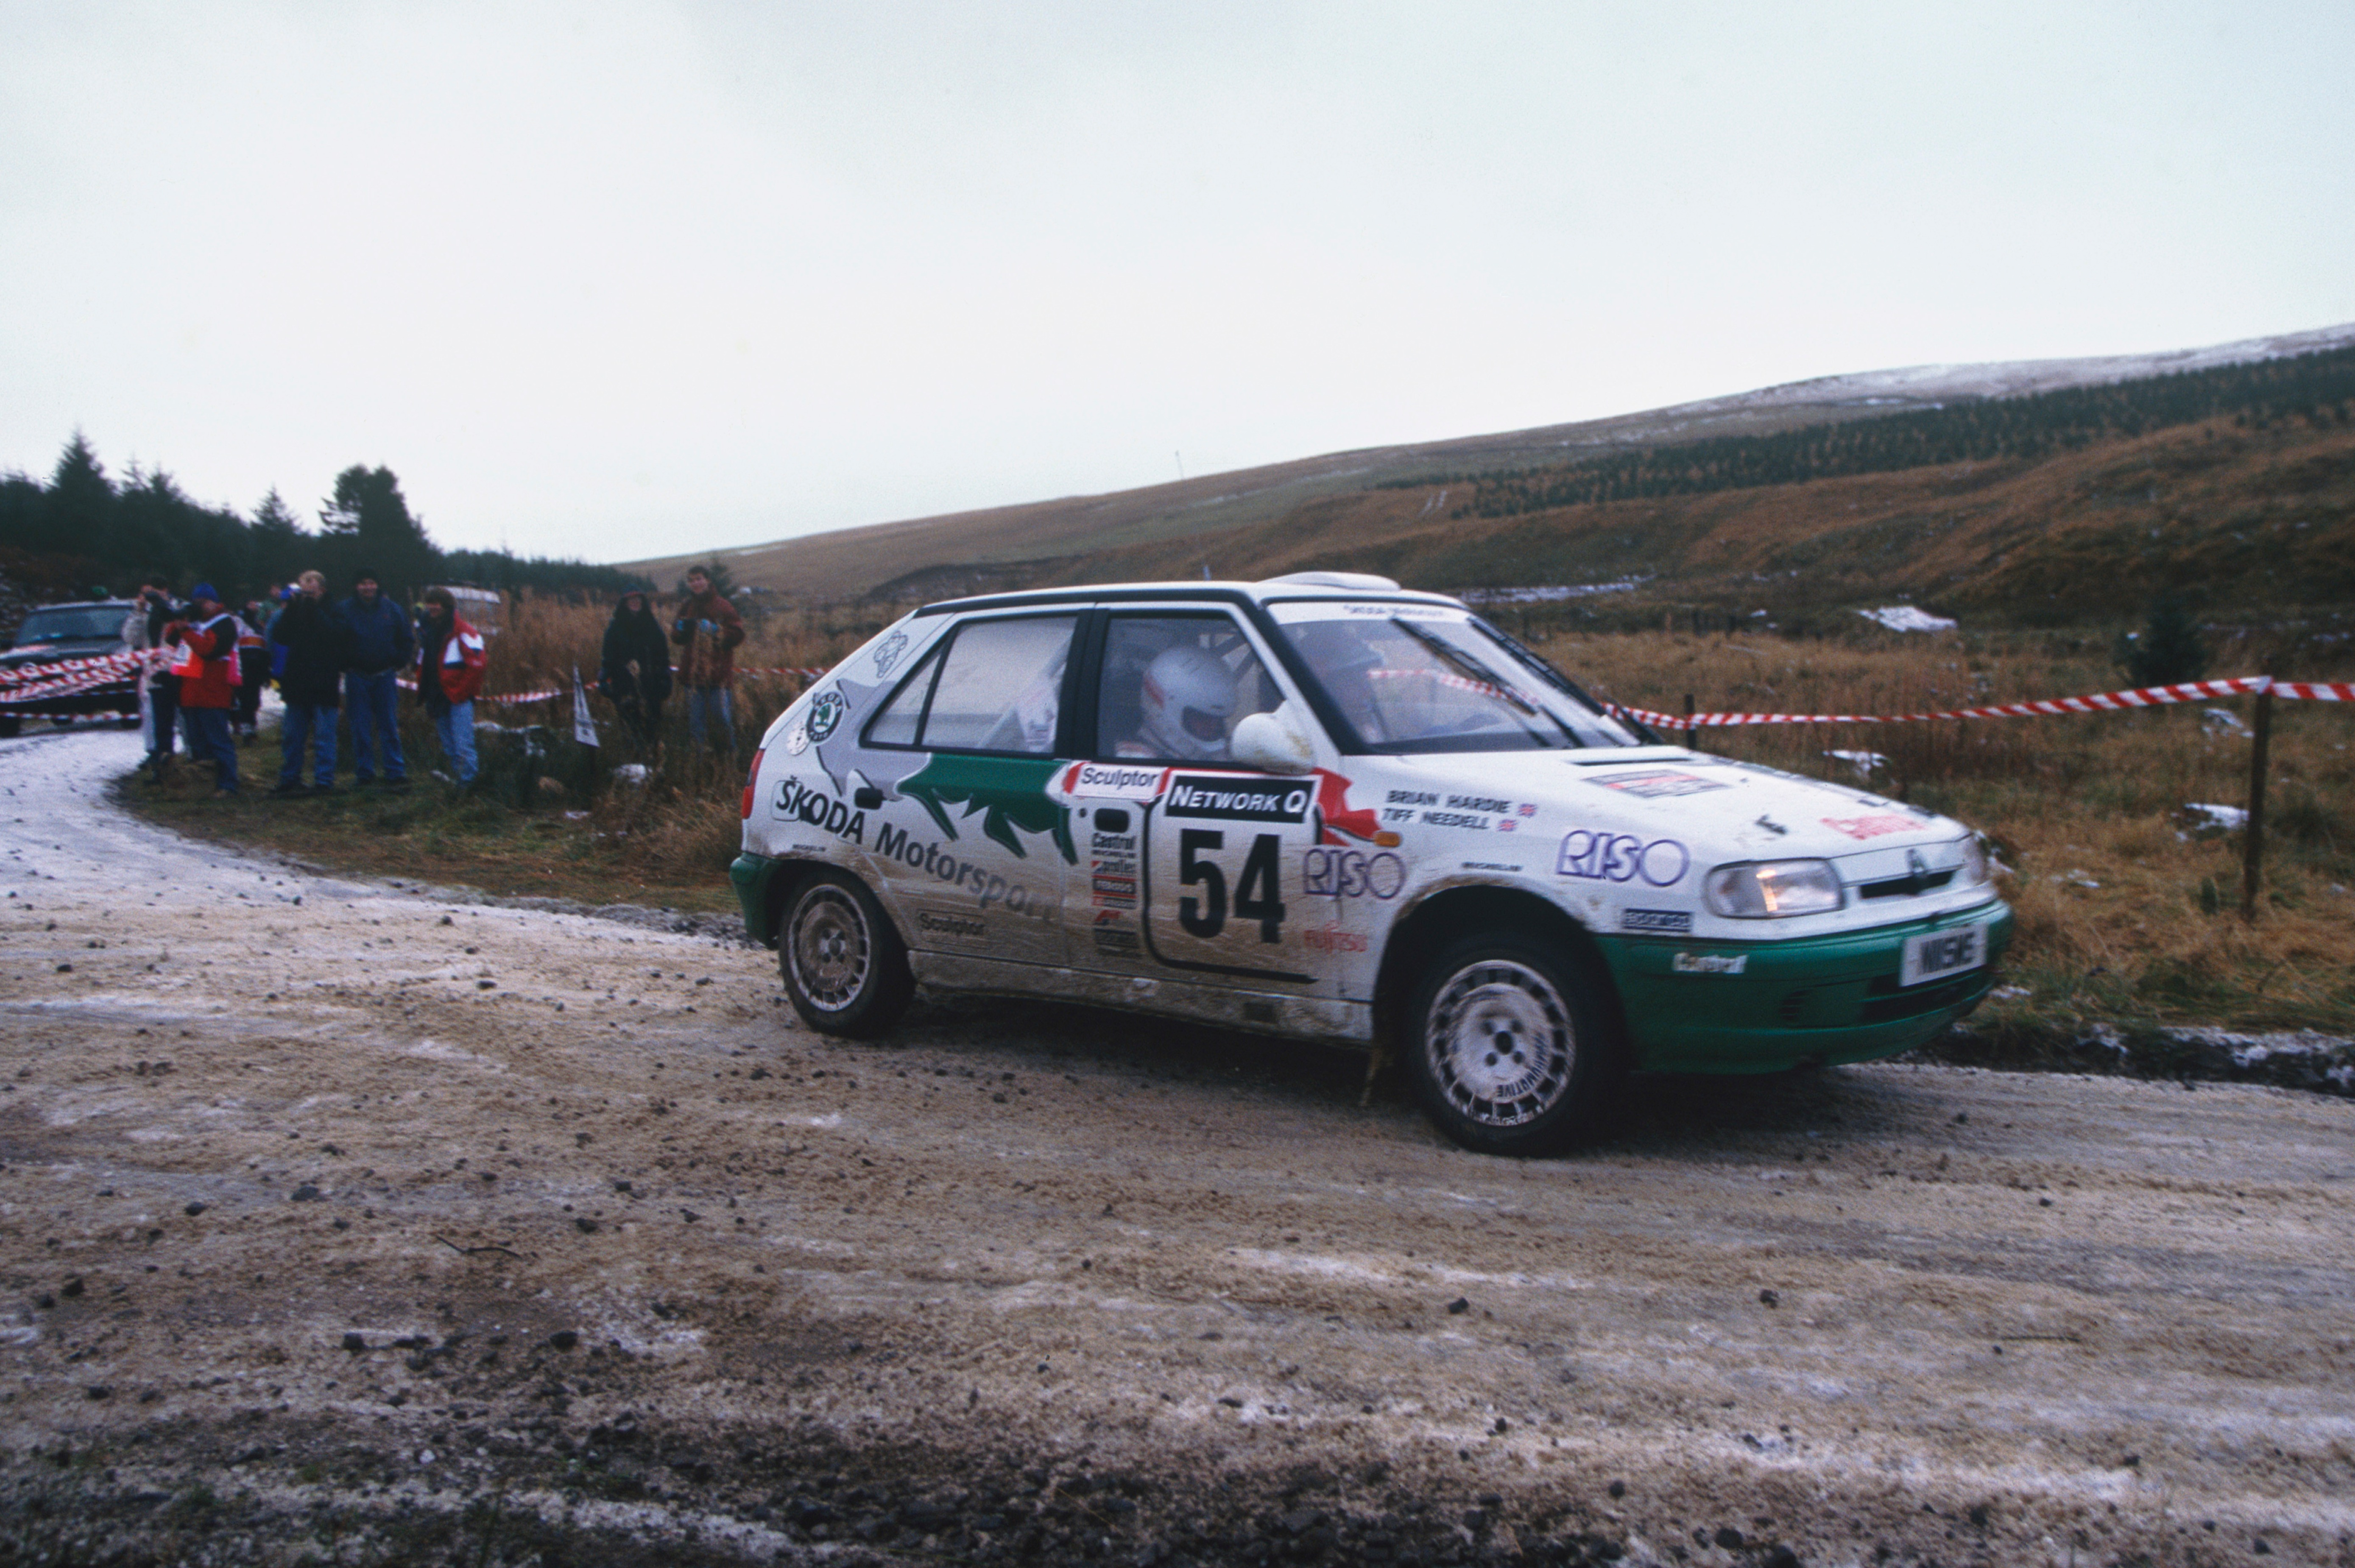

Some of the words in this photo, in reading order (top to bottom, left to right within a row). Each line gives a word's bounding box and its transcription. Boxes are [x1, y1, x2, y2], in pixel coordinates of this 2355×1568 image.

[1081, 767, 1158, 790] Sculptor
[777, 776, 865, 844] ŠKODA
[1170, 785, 1281, 812] NETWORK
[1284, 790, 1308, 813] Q
[1382, 808, 1416, 822] TIFF
[1420, 811, 1490, 829] NEEDELL
[1387, 790, 1440, 806] BRIAN
[1446, 795, 1512, 813] HARDIE
[1304, 849, 1406, 900] RISO
[1556, 830, 1691, 887] RISO
[1179, 829, 1286, 944] 54
